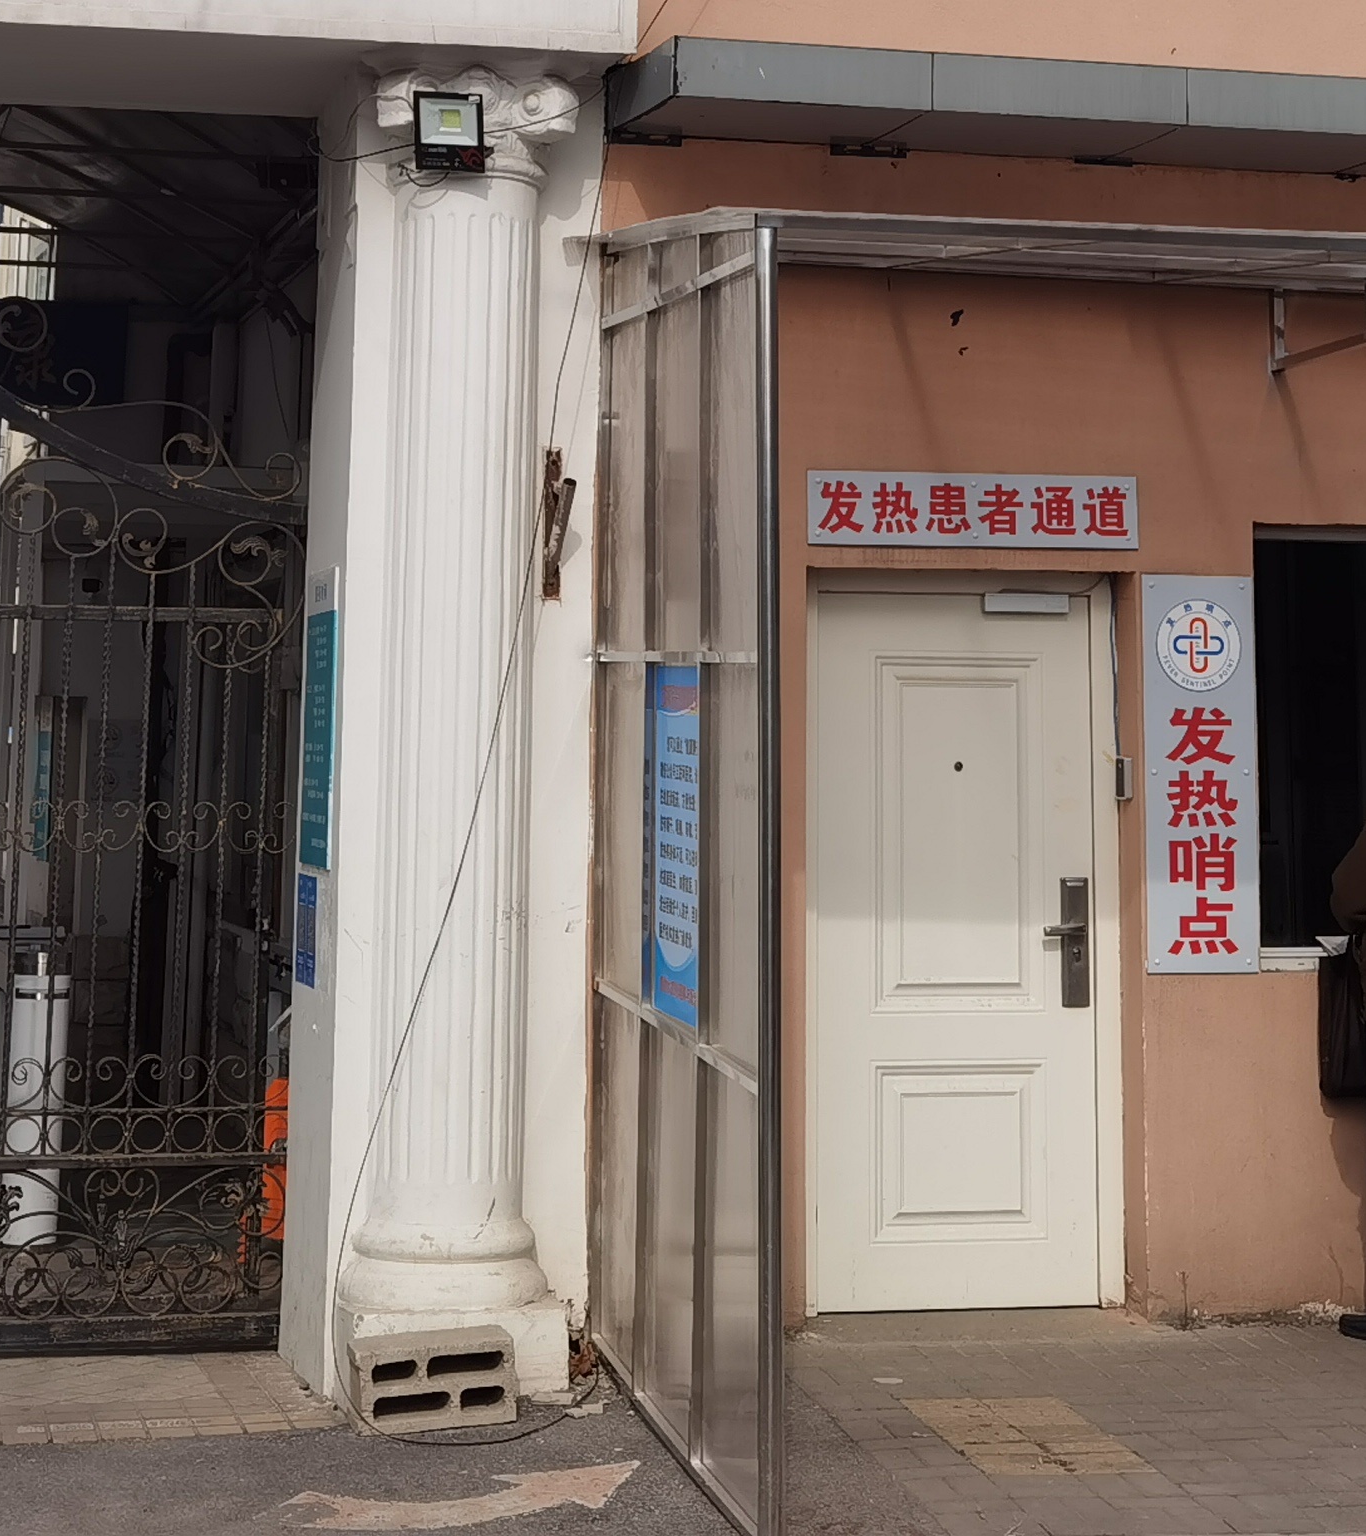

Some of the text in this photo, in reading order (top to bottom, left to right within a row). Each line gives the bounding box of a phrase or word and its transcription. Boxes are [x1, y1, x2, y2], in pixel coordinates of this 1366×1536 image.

[816, 480, 1131, 538] 发热患者通道
[1181, 678, 1216, 688] SENTINEL
[1165, 706, 1239, 956] 发热哨点
